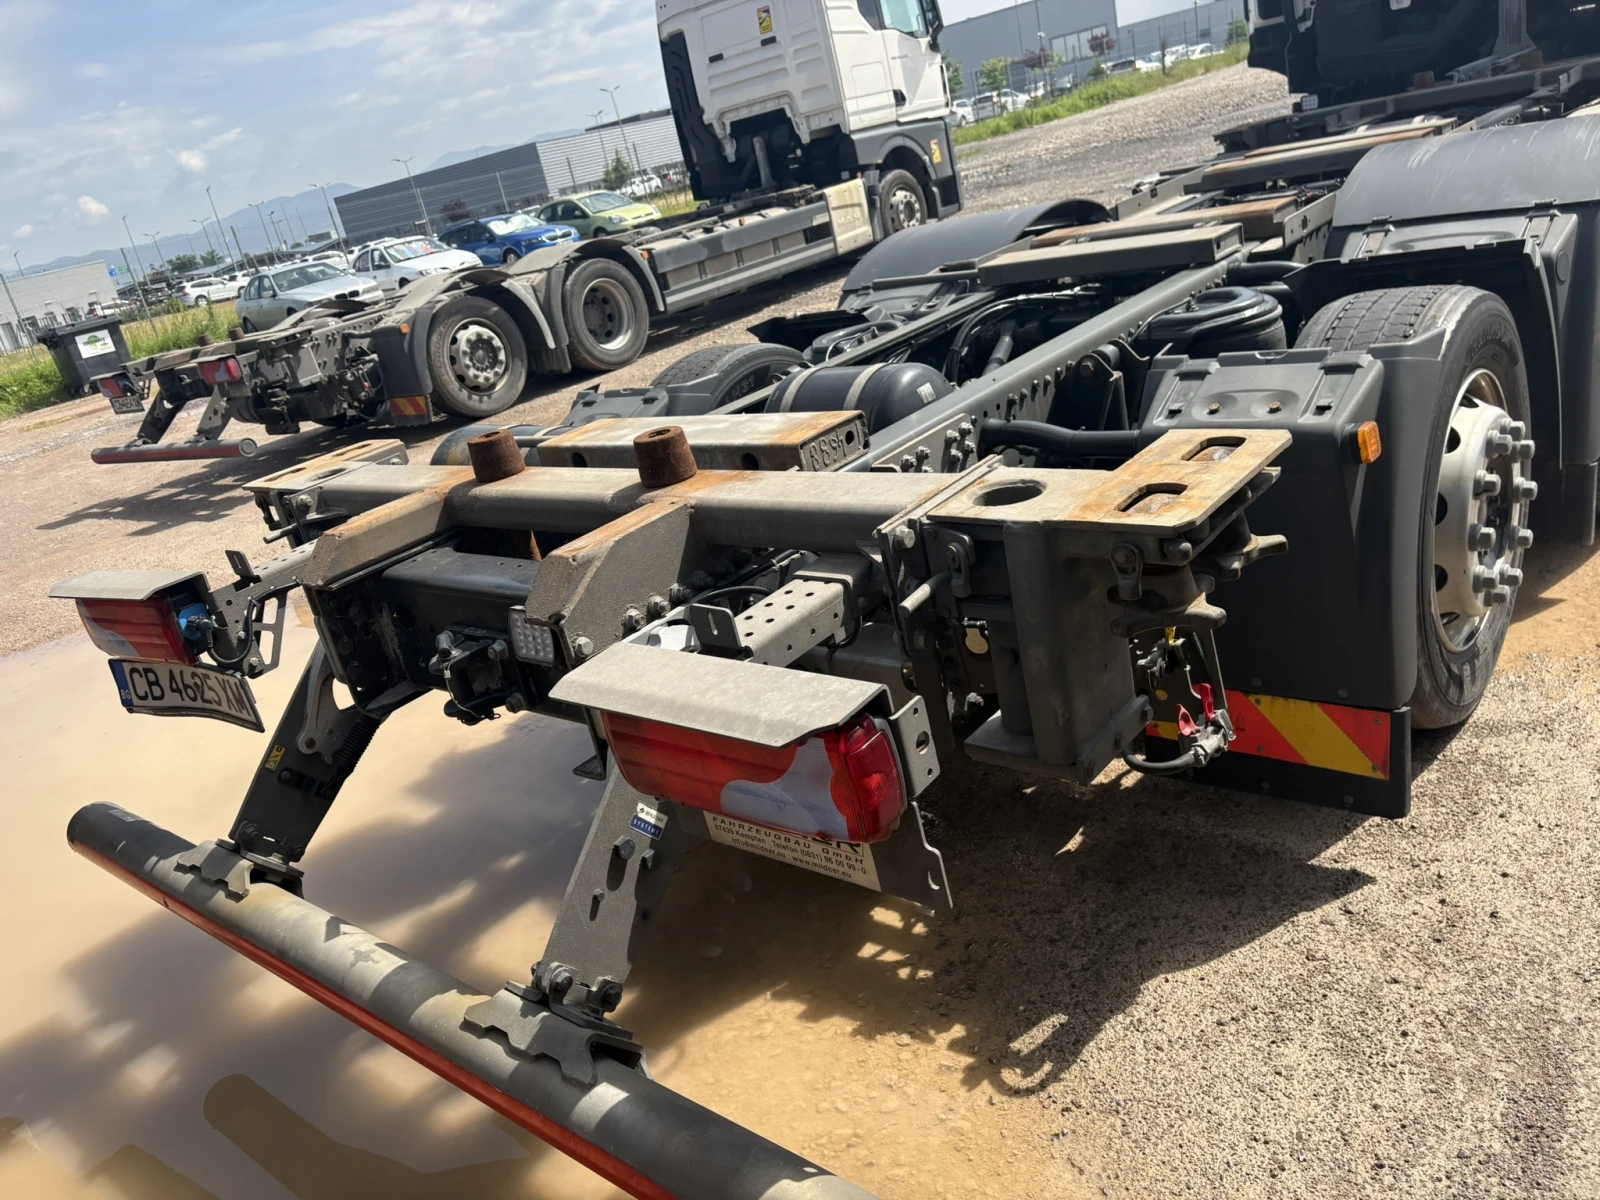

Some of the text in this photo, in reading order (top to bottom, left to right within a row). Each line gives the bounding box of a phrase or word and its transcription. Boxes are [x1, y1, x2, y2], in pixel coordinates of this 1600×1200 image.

[121, 689, 132, 700] BG
[129, 667, 165, 701] CB
[168, 668, 222, 707] 4625
[712, 816, 811, 849] FAHRZEUGBAU
[821, 847, 863, 865] GmbH
[735, 829, 767, 844] Kempten
[772, 840, 799, 854] Telefon
